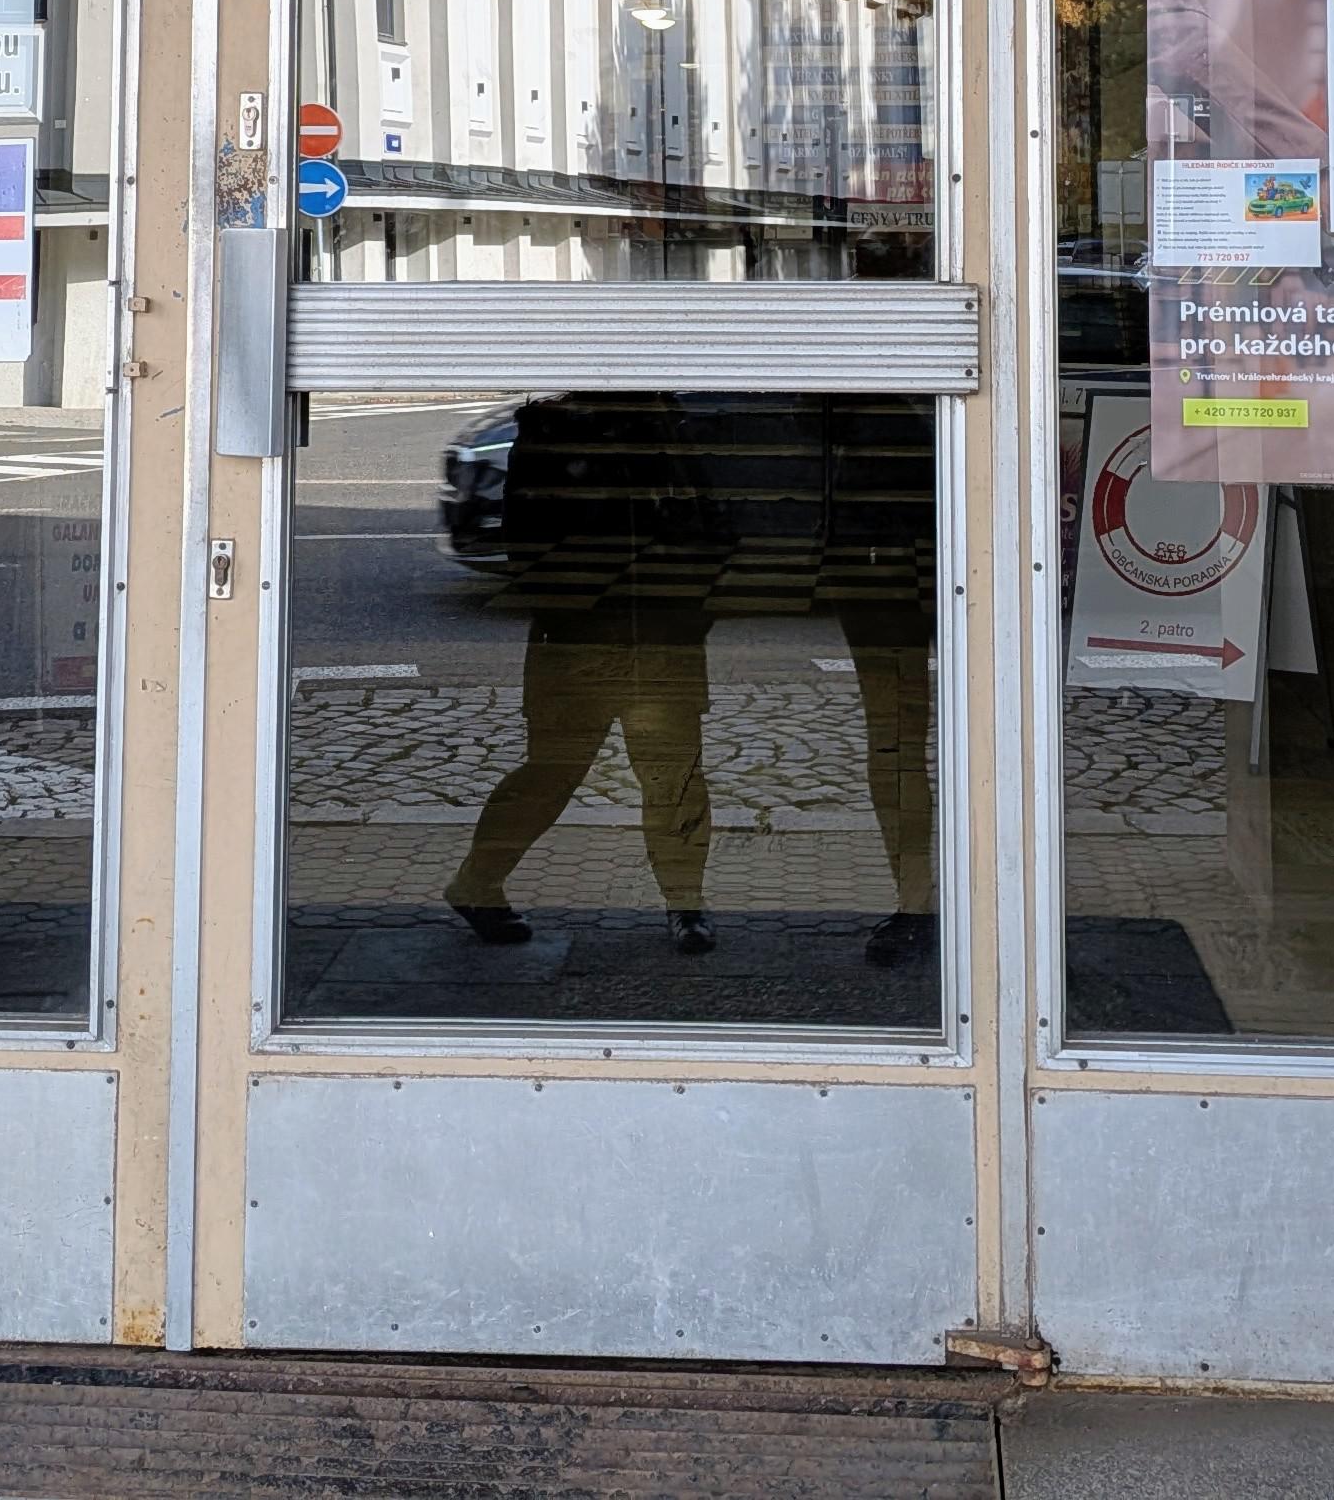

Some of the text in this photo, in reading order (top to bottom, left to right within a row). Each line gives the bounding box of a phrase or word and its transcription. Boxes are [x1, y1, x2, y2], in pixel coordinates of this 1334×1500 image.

[1180, 301, 1307, 324] Prémiová
[1180, 336, 1226, 360] pro
[1196, 372, 1230, 380] Trutnov
[1204, 408, 1297, 417] 420 773 720 937
[1140, 620, 1194, 638] 2. patro
